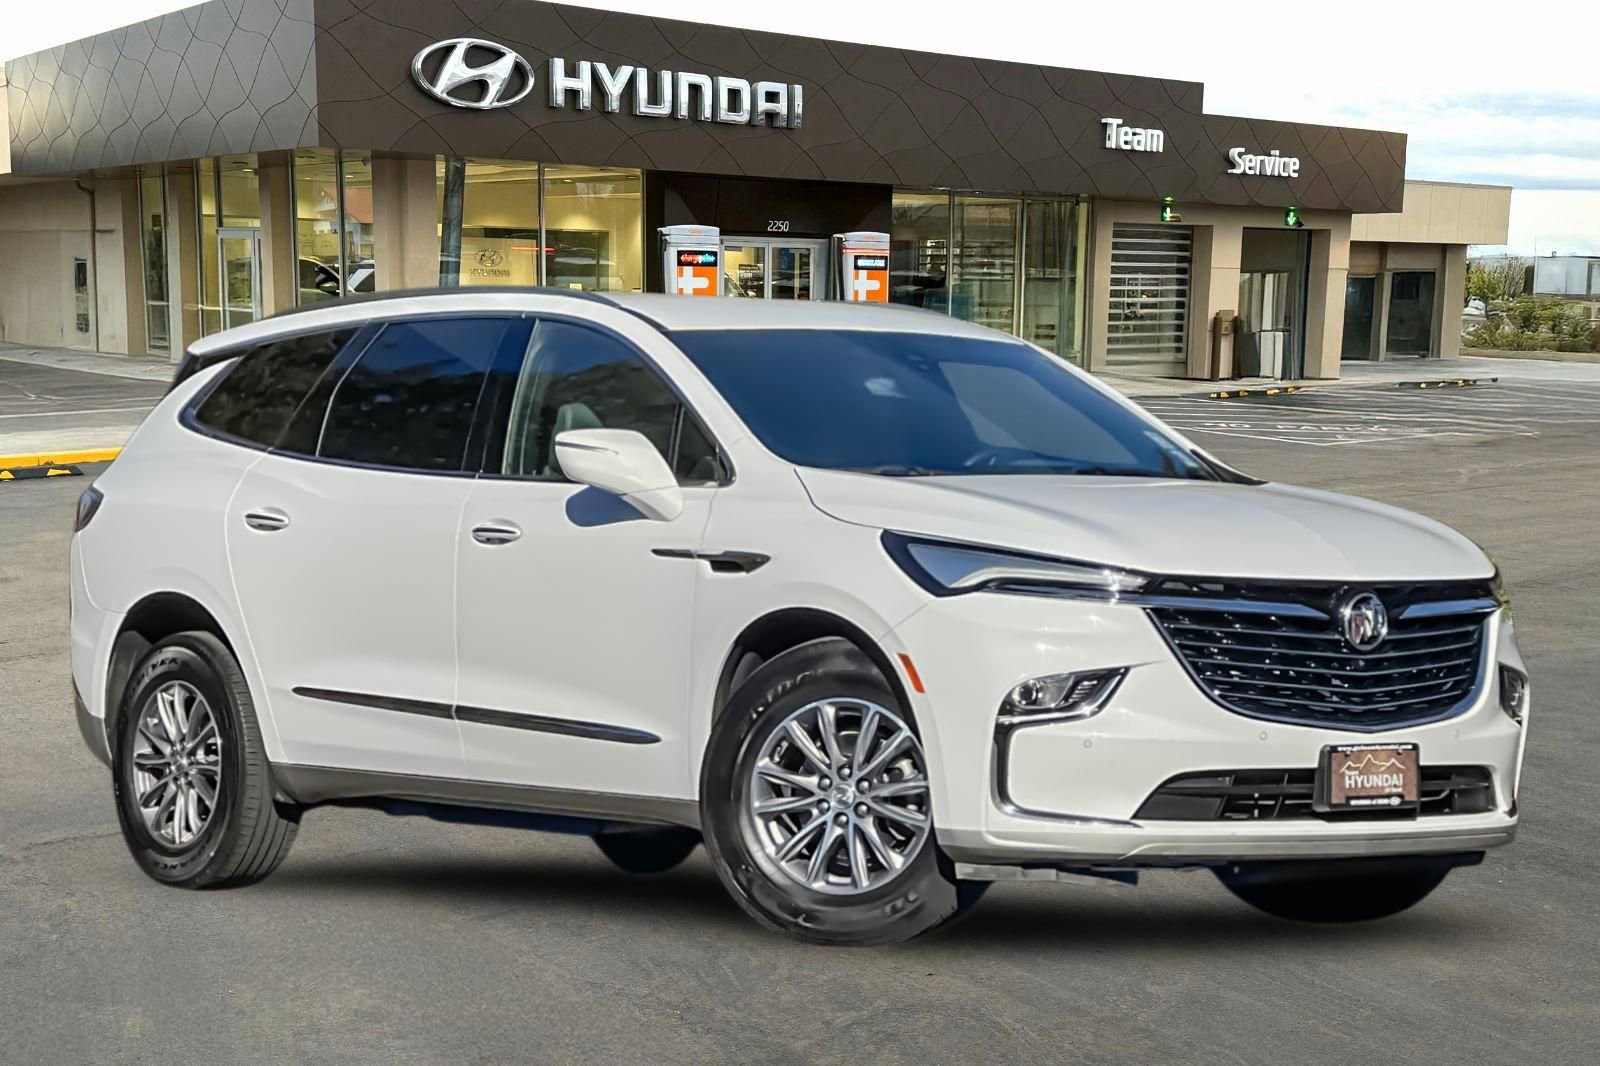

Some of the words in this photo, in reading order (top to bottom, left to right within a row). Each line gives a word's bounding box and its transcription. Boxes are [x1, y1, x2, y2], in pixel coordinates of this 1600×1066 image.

[549, 57, 803, 129] HYUNDAI
[1101, 117, 1164, 152] Team
[1227, 147, 1300, 178] Service
[767, 220, 790, 232] 2250
[1344, 773, 1404, 789] HYUNDAI
